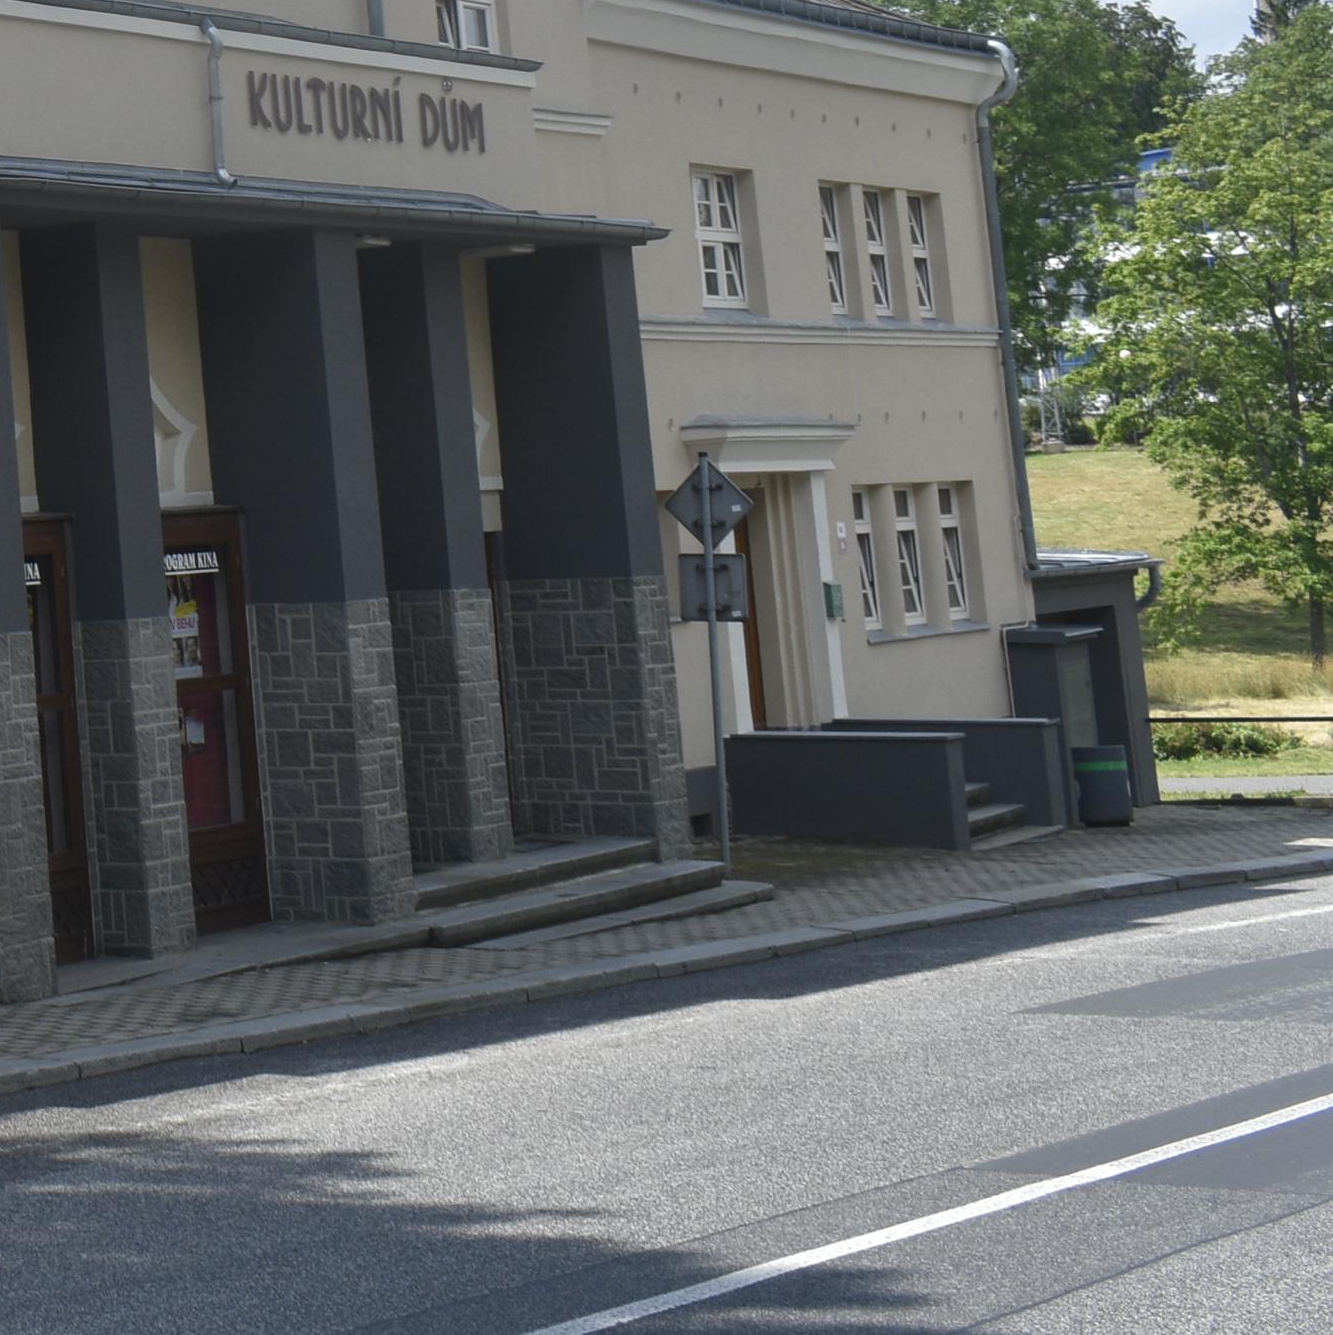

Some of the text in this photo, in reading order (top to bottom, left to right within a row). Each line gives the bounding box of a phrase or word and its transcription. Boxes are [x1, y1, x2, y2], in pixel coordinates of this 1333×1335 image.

[247, 70, 486, 153] KULTURNÍ DŮM
[164, 551, 219, 570] OGRAM KINA
[24, 562, 41, 580] INA
